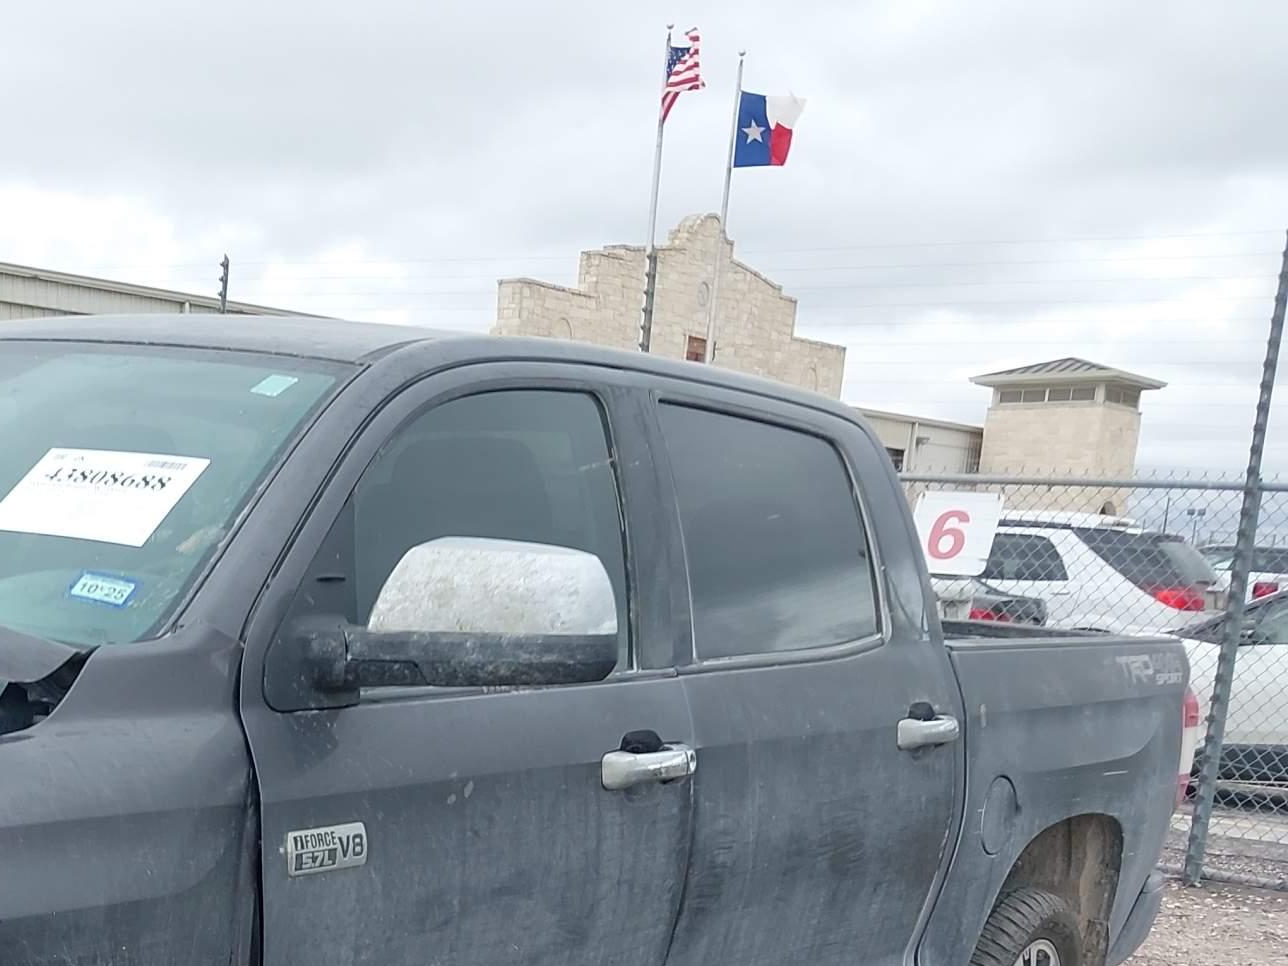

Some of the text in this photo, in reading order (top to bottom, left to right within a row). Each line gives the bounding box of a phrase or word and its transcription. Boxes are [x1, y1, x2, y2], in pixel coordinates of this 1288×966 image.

[45, 467, 172, 491] 43808688
[927, 509, 970, 560] 6
[337, 833, 364, 860] V8
